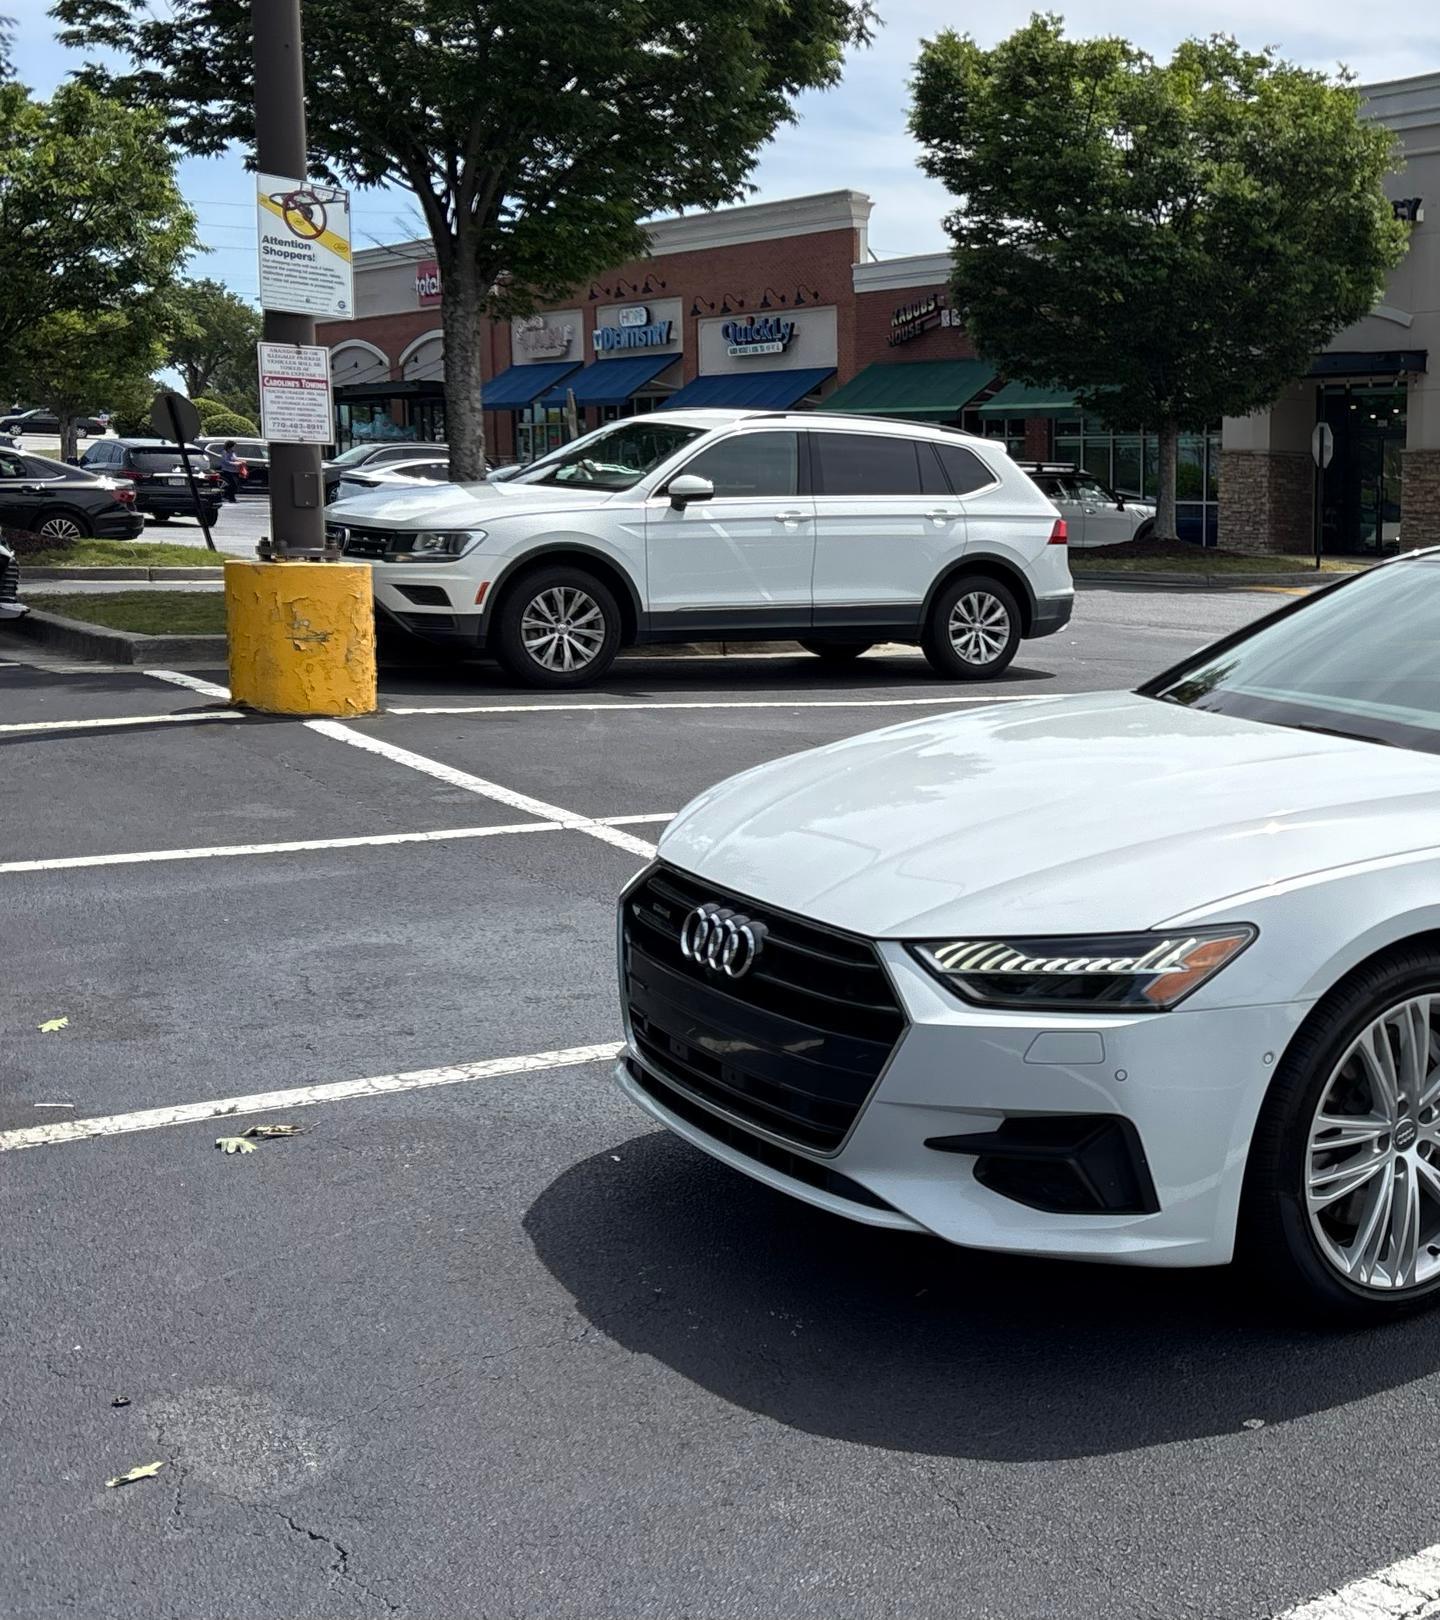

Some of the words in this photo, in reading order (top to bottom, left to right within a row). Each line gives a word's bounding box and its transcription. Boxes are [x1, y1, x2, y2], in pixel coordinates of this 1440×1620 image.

[262, 235, 312, 251] Attention
[262, 245, 316, 262] Shoppers!
[602, 320, 671, 350] DENTISTRY
[301, 379, 327, 390] TOWING
